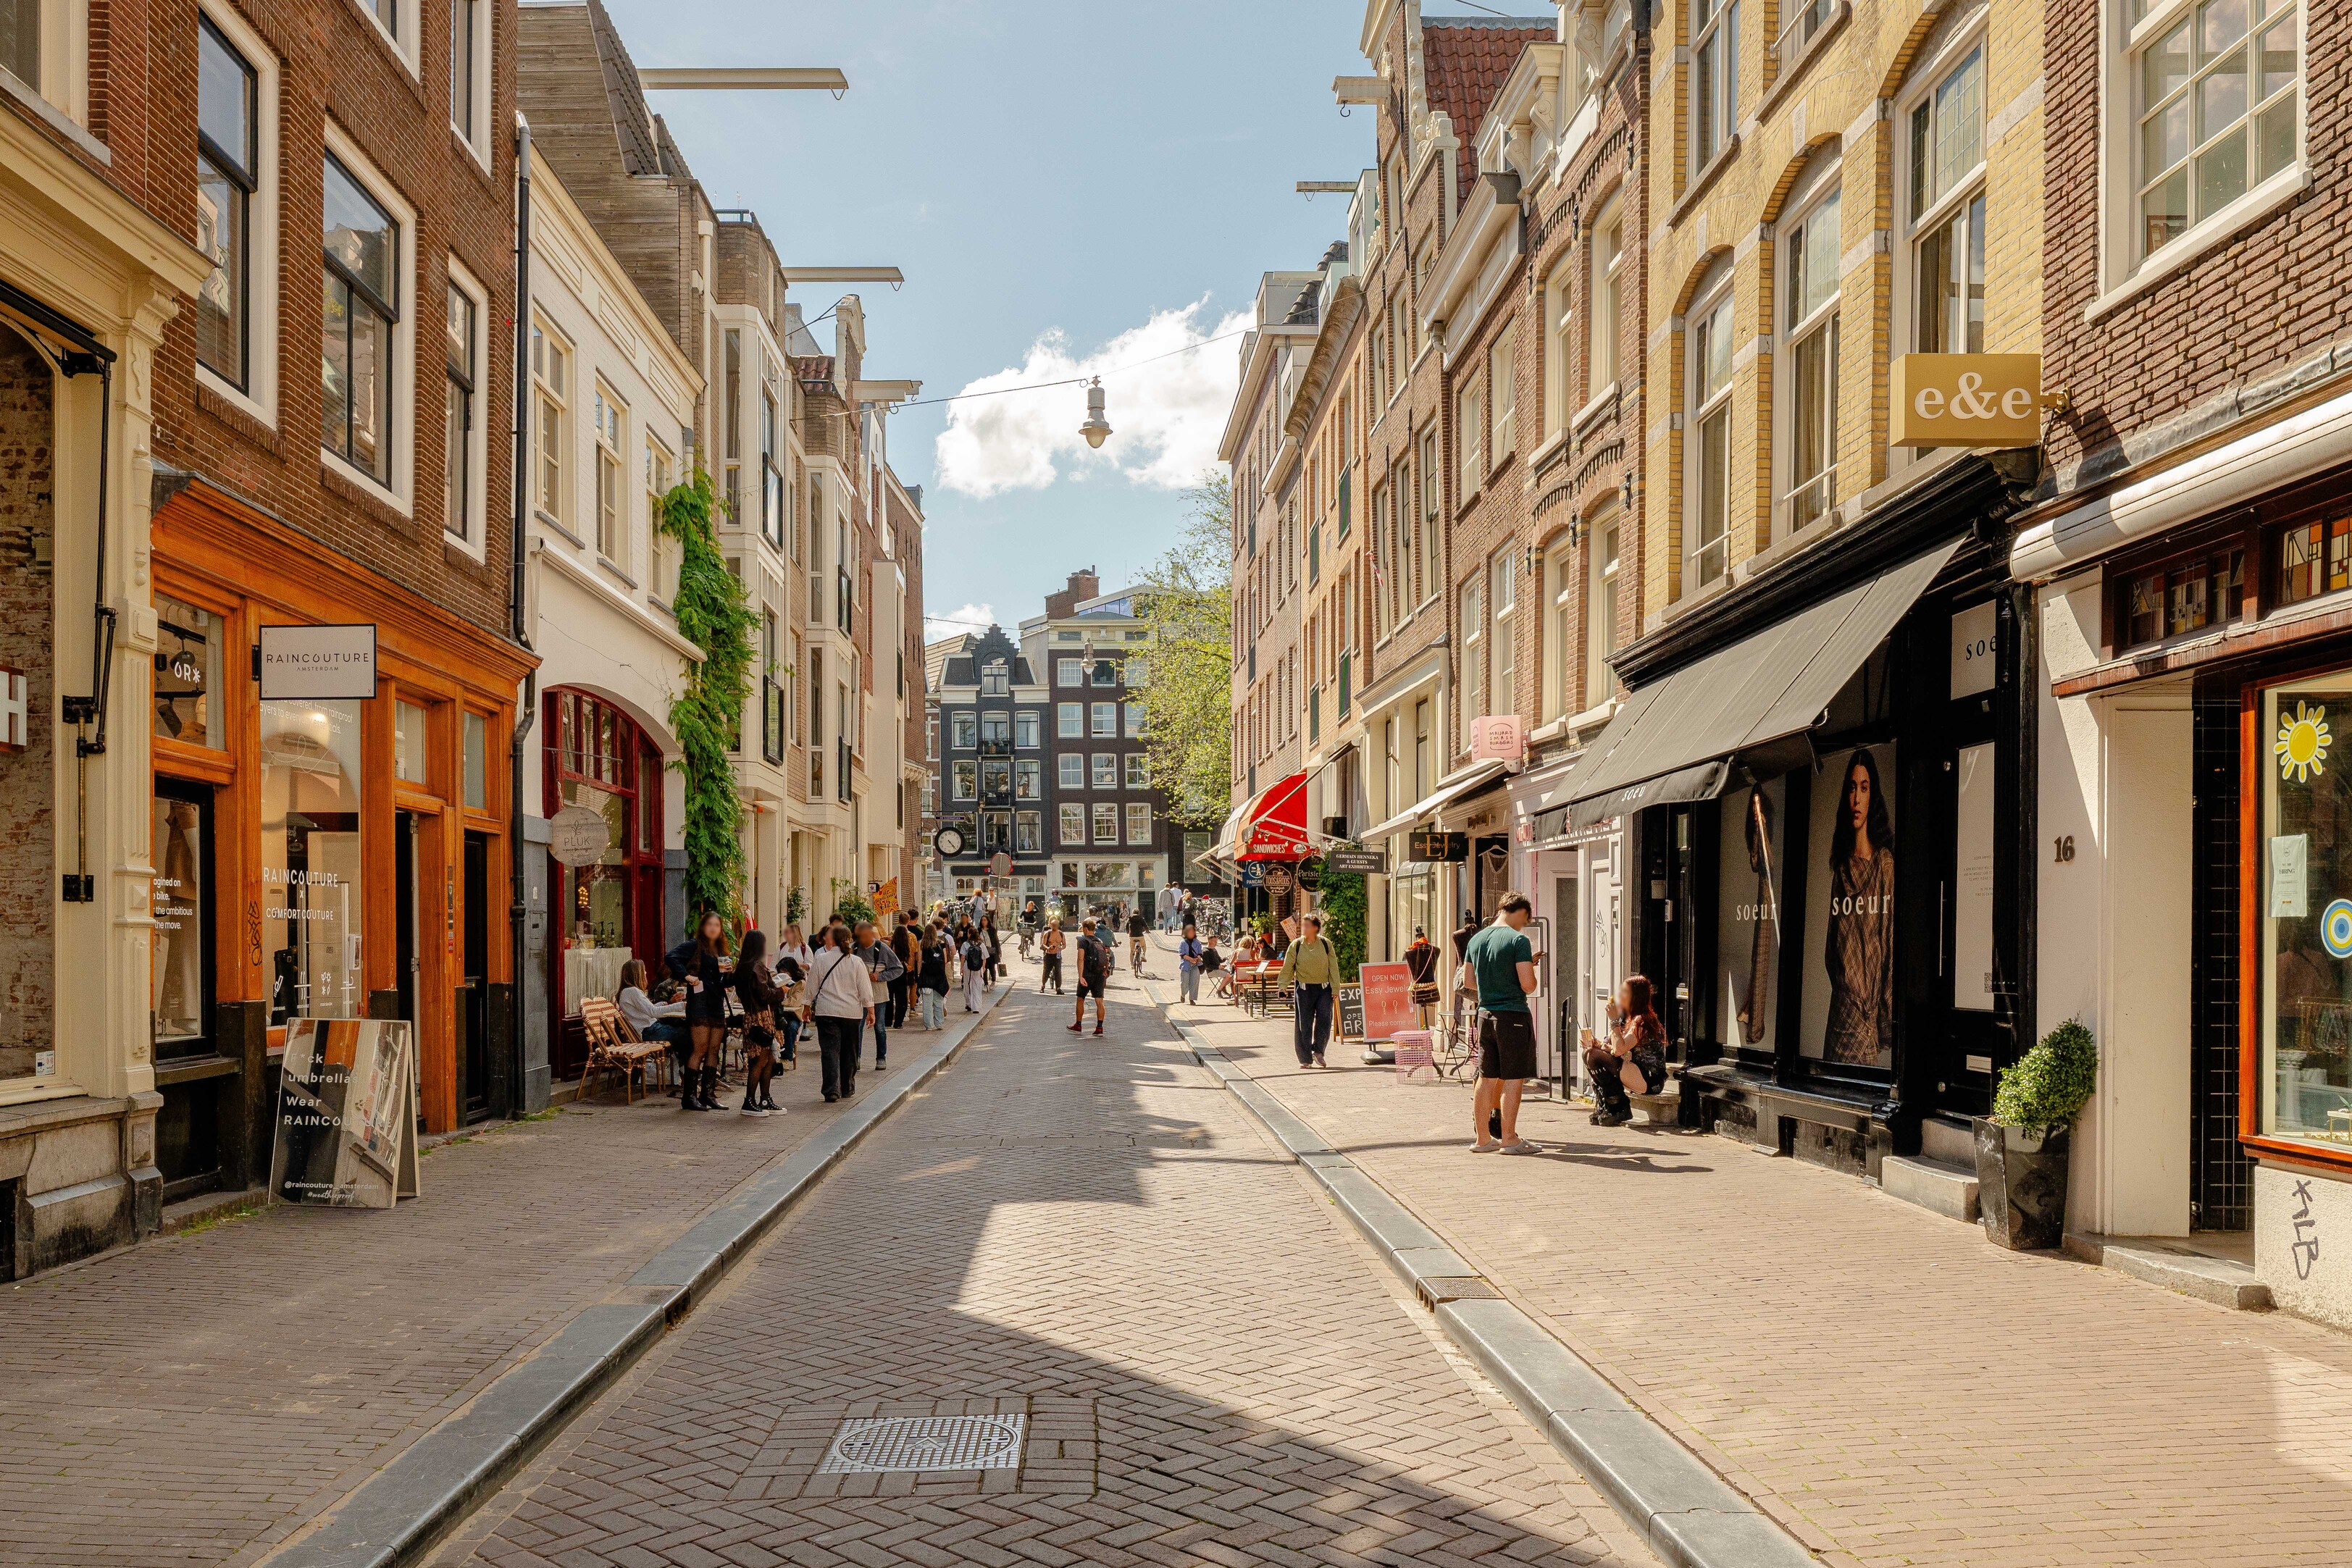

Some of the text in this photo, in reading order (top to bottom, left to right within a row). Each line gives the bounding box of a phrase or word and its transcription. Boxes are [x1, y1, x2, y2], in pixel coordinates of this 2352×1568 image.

[1914, 372, 2032, 420] e&e
[1966, 636, 1996, 661] soe
[267, 653, 369, 663] RAINCOUTURE
[260, 703, 277, 716] ayers
[278, 708, 284, 717] to
[314, 703, 327, 714] from
[329, 708, 353, 724] rainproof
[564, 836, 590, 847] PLUK
[1253, 844, 1286, 854] SANDWICHES
[2054, 835, 2076, 863] 16
[153, 876, 173, 888] agined
[263, 867, 338, 888] RAINCOUTURE
[156, 891, 170, 900] bike.
[156, 905, 193, 915] the ambitious
[1832, 894, 1891, 915] soeur
[1736, 903, 1777, 921] soeur
[1339, 989, 1361, 1001] EXP
[1365, 985, 1409, 994] Essy Jewelr
[1344, 1020, 1363, 1034] AR
[288, 1072, 359, 1083] umbrellas
[286, 1096, 322, 1107] Wear
[307, 1190, 354, 1202] #weatherproof
